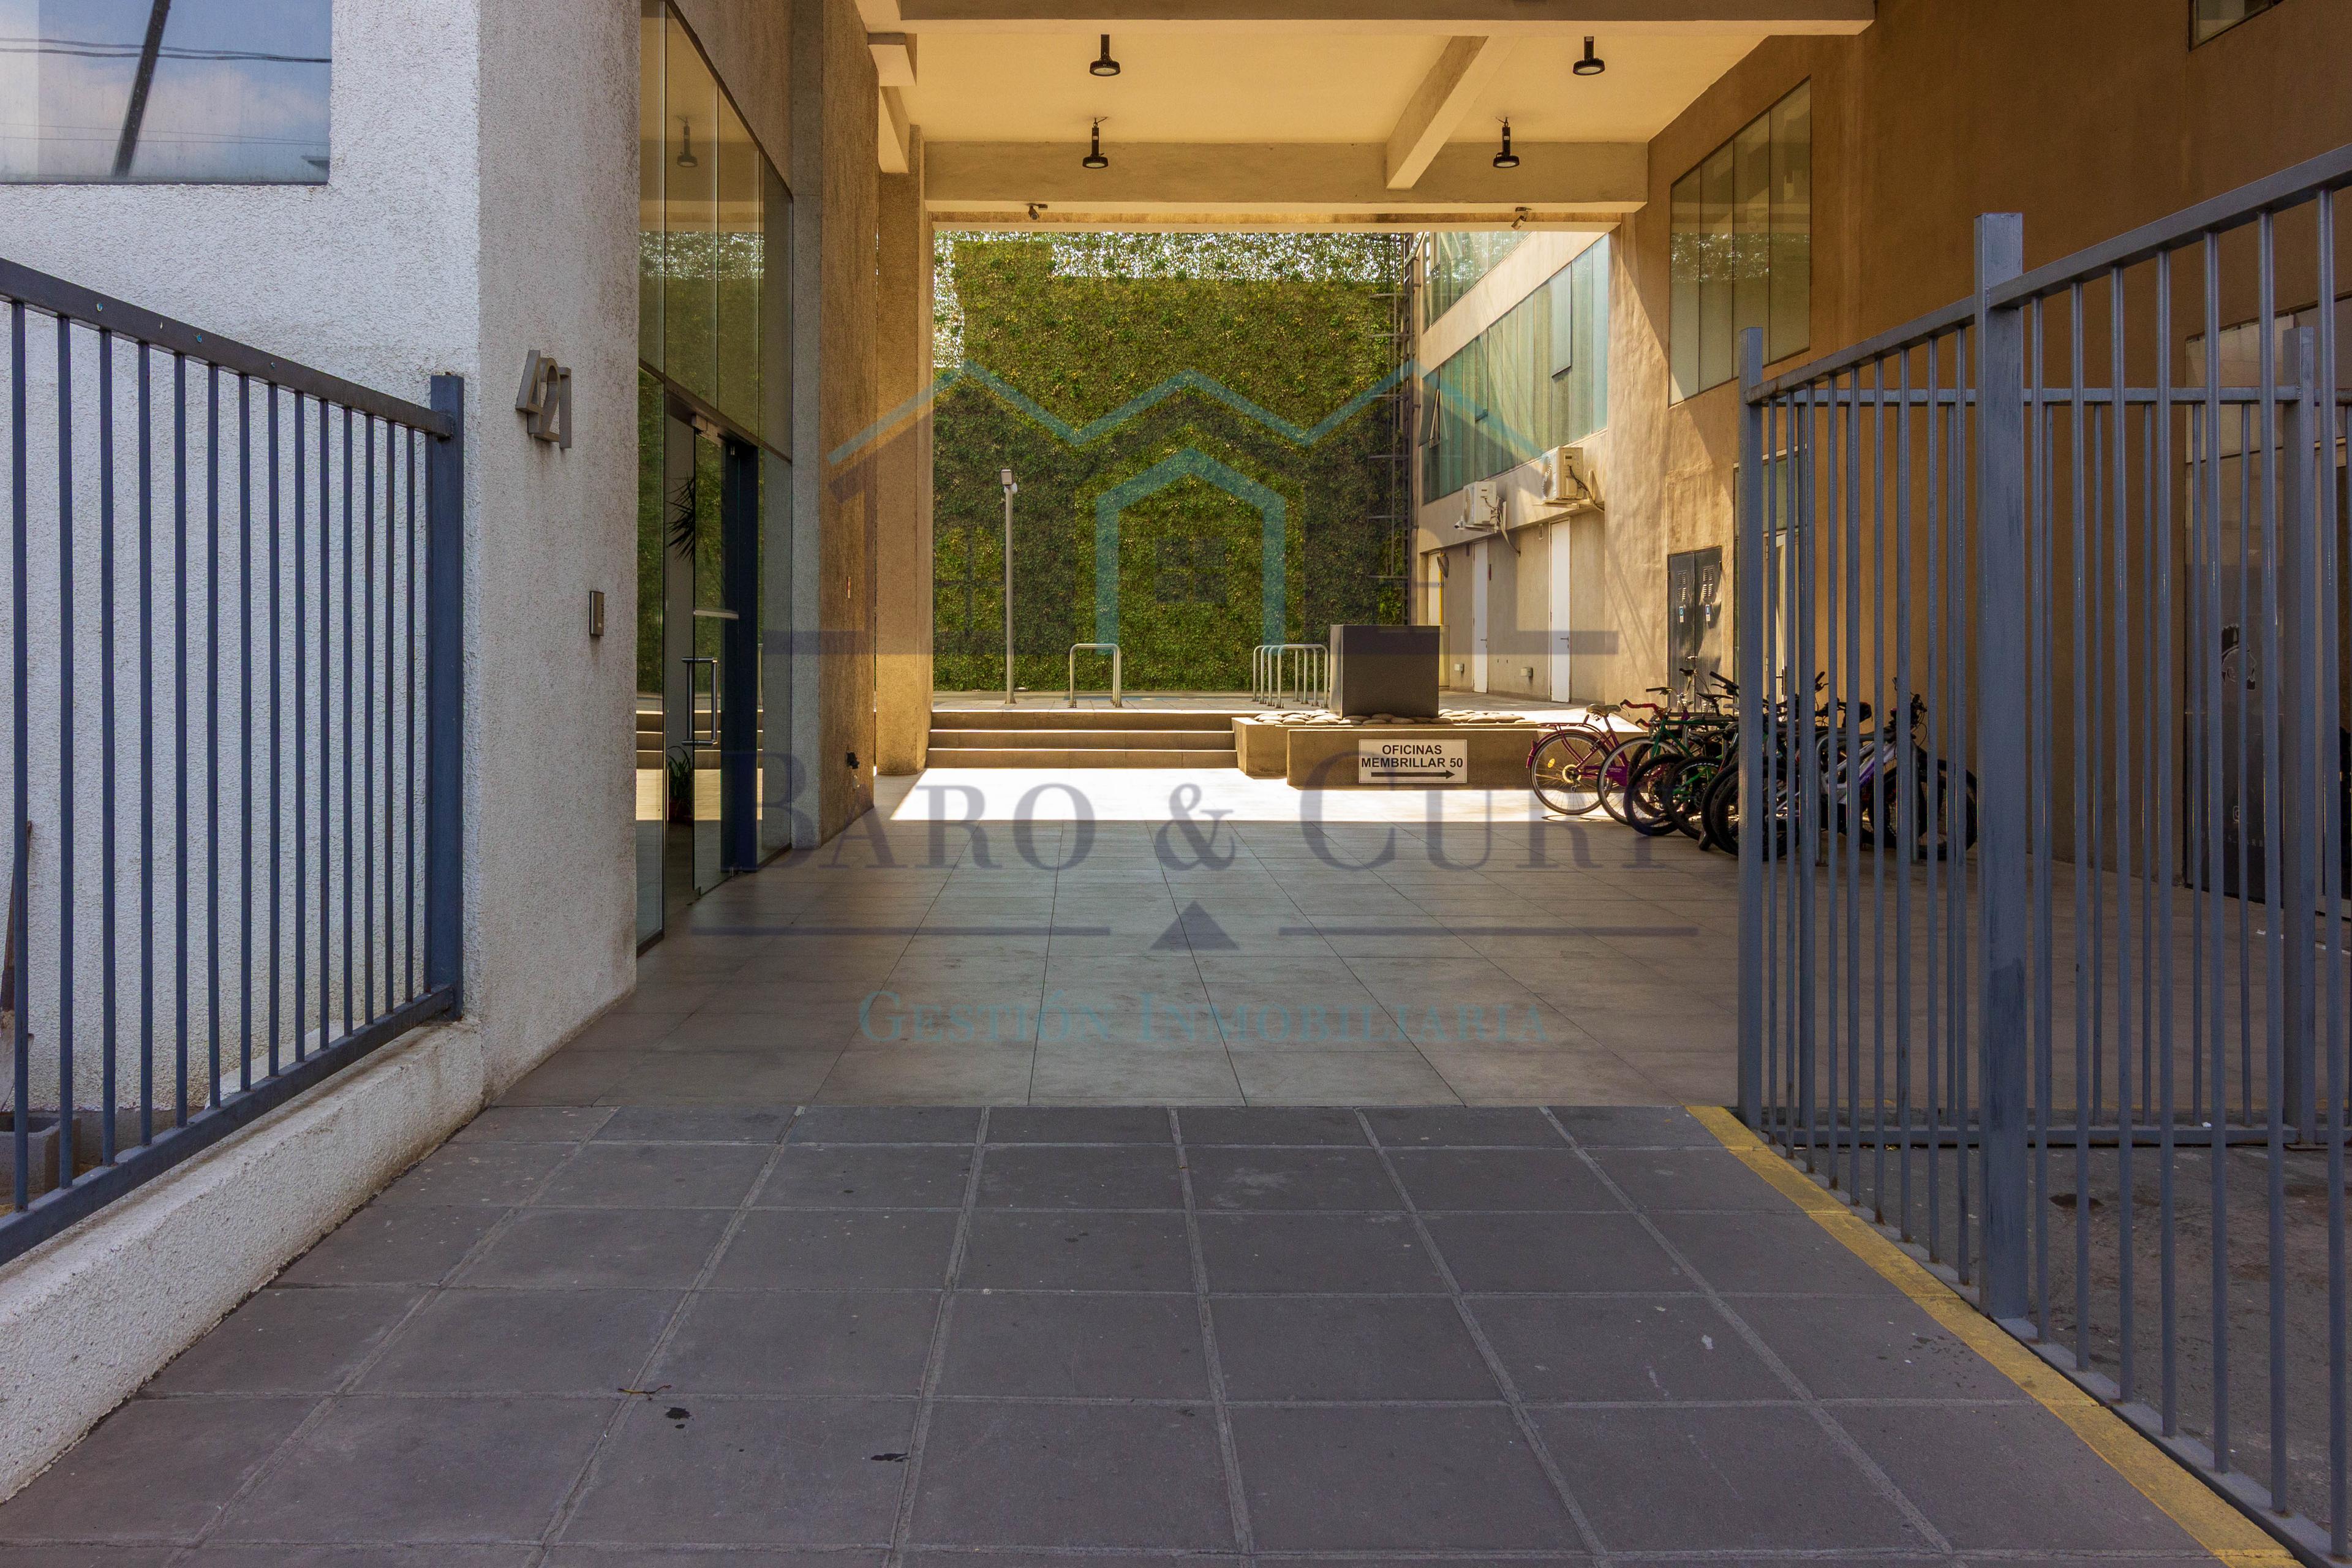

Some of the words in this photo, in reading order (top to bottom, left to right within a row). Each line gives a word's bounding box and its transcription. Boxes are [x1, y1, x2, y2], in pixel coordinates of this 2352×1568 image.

[515, 350, 572, 448] 421
[1382, 744, 1442, 755] OFICINAS
[1361, 757, 1446, 768] MEMBRILLAR
[1449, 757, 1463, 768] 50
